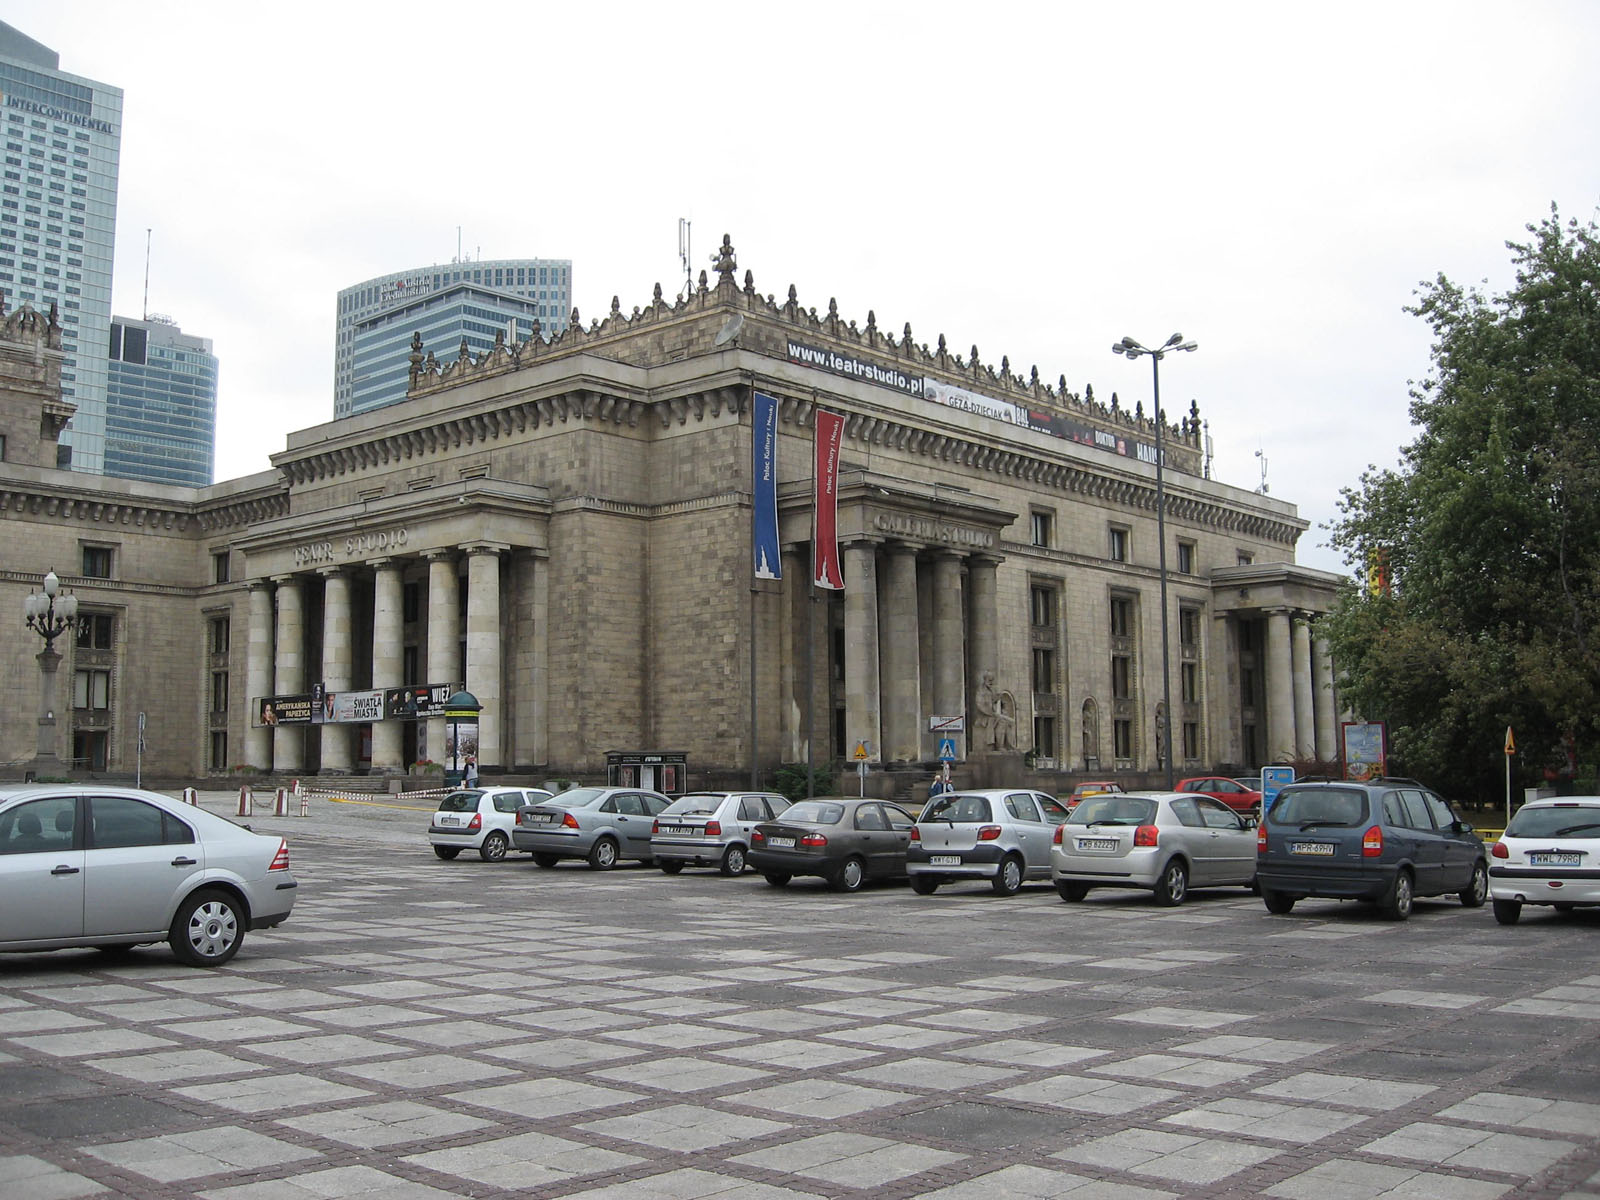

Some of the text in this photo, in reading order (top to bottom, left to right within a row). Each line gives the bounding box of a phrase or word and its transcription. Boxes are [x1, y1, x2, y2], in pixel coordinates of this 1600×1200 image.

[788, 343, 923, 393] www.teatrstudio.pl
[764, 432, 773, 459] Kultury
[1095, 430, 1116, 448] DOKTOR
[827, 447, 836, 474] Kultury
[294, 528, 408, 563] TEATR STUDIO
[353, 697, 382, 709] ŚWIATŁA
[353, 707, 378, 719] MIASTA
[1296, 843, 1313, 852] WPR
[1536, 854, 1579, 864] WWL 79RG
